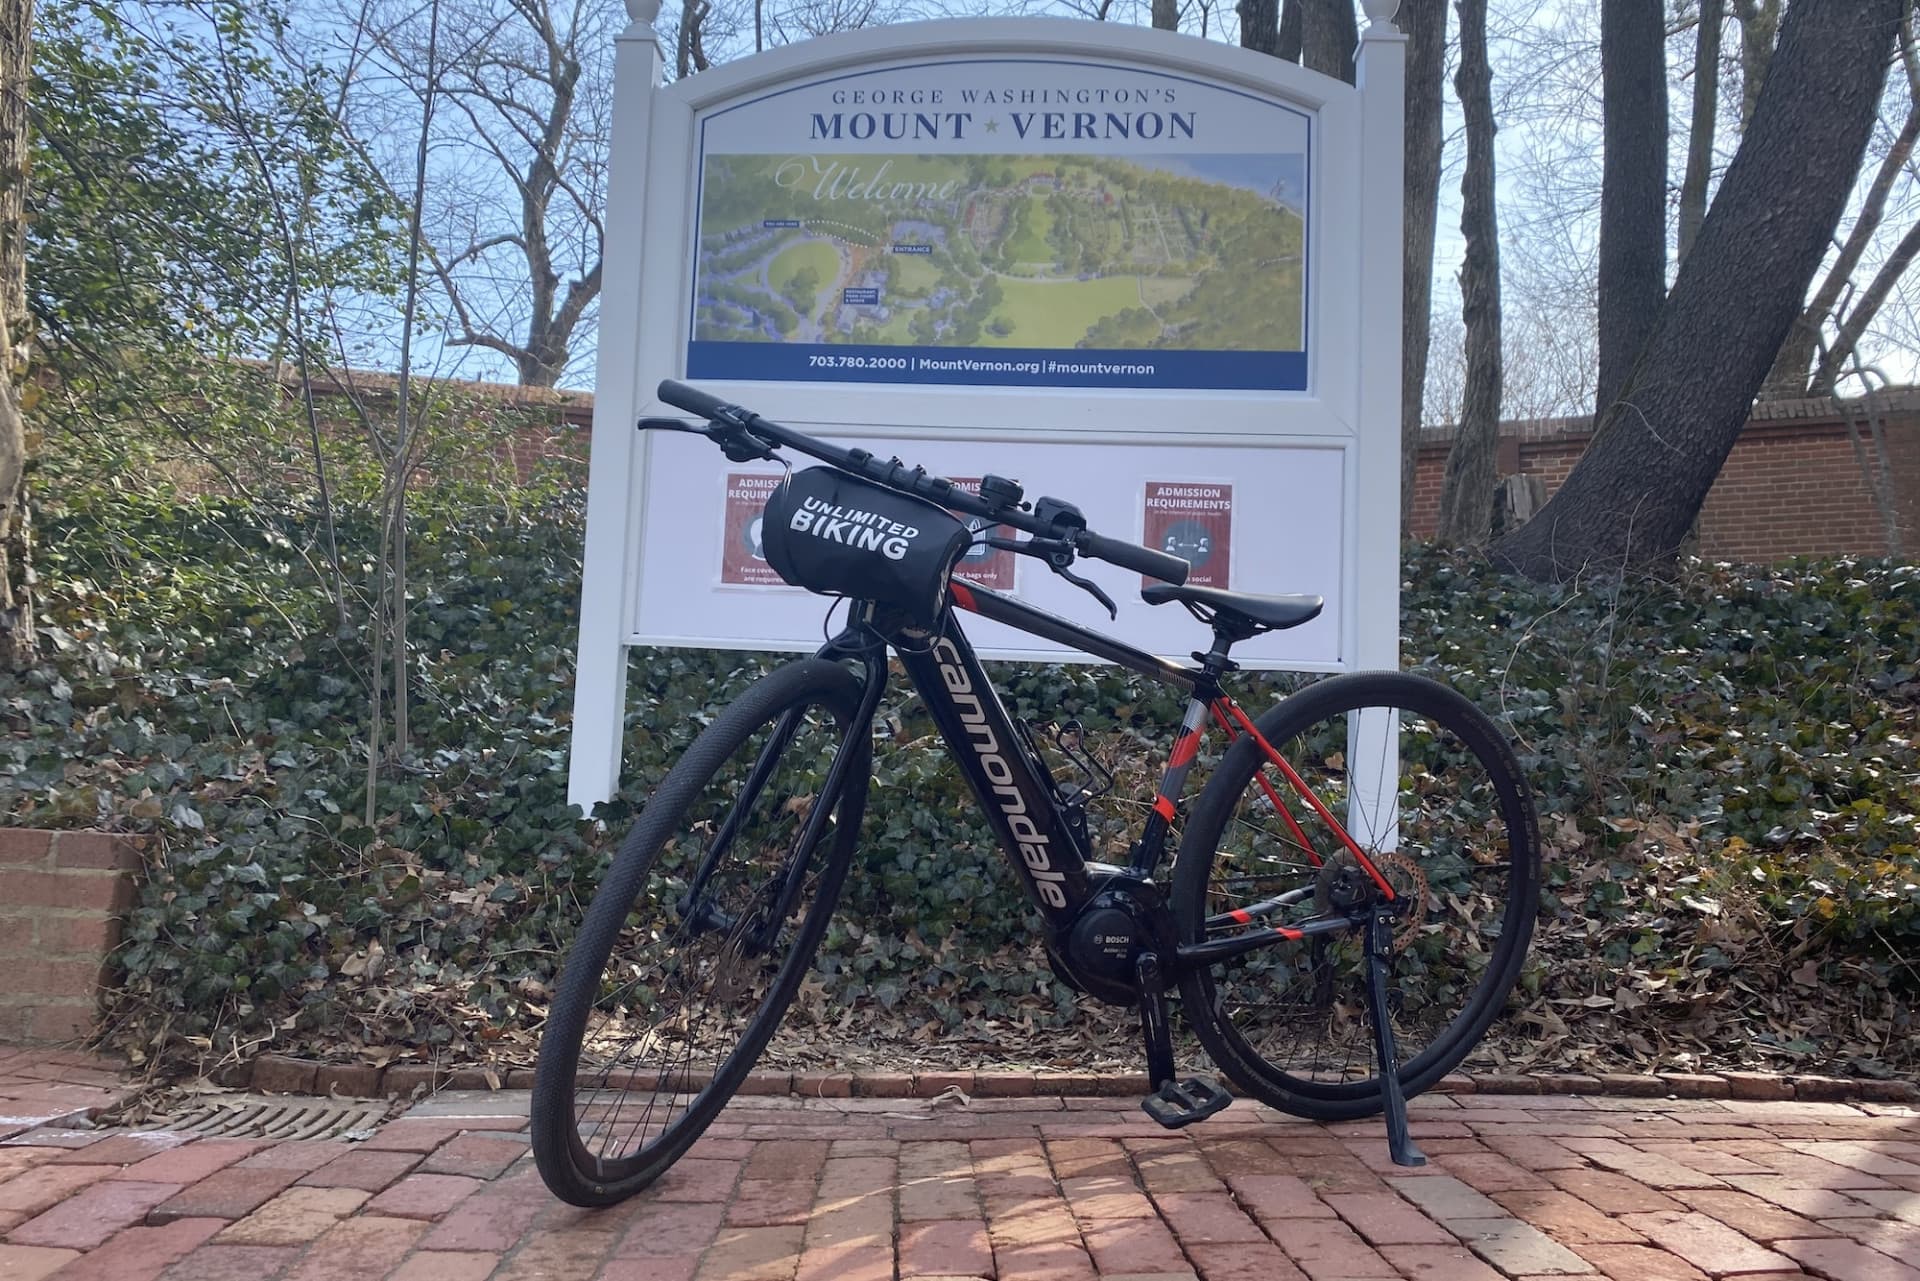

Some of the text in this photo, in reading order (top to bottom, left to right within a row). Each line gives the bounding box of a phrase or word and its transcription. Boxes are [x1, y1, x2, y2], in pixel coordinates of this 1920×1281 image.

[832, 88, 1177, 104] GEORGE WASHINGTON'S
[809, 111, 1197, 140] MOUNT VERNON
[775, 154, 961, 200] Welcome
[809, 355, 907, 369] 703.780.2000
[919, 358, 1039, 374] MountVernon.org
[1047, 360, 1155, 375] #mountvernon
[738, 479, 783, 489] ADMISS
[728, 489, 775, 500] REQUIR
[1157, 487, 1221, 498] ADMISSION
[1146, 498, 1232, 510] REQUIREMENTS
[803, 496, 919, 538] UNLIMITED
[790, 508, 909, 560] BIKING
[1191, 575, 1212, 583] social
[929, 636, 1067, 909] cannondale
[1105, 935, 1130, 944] BOSCH
